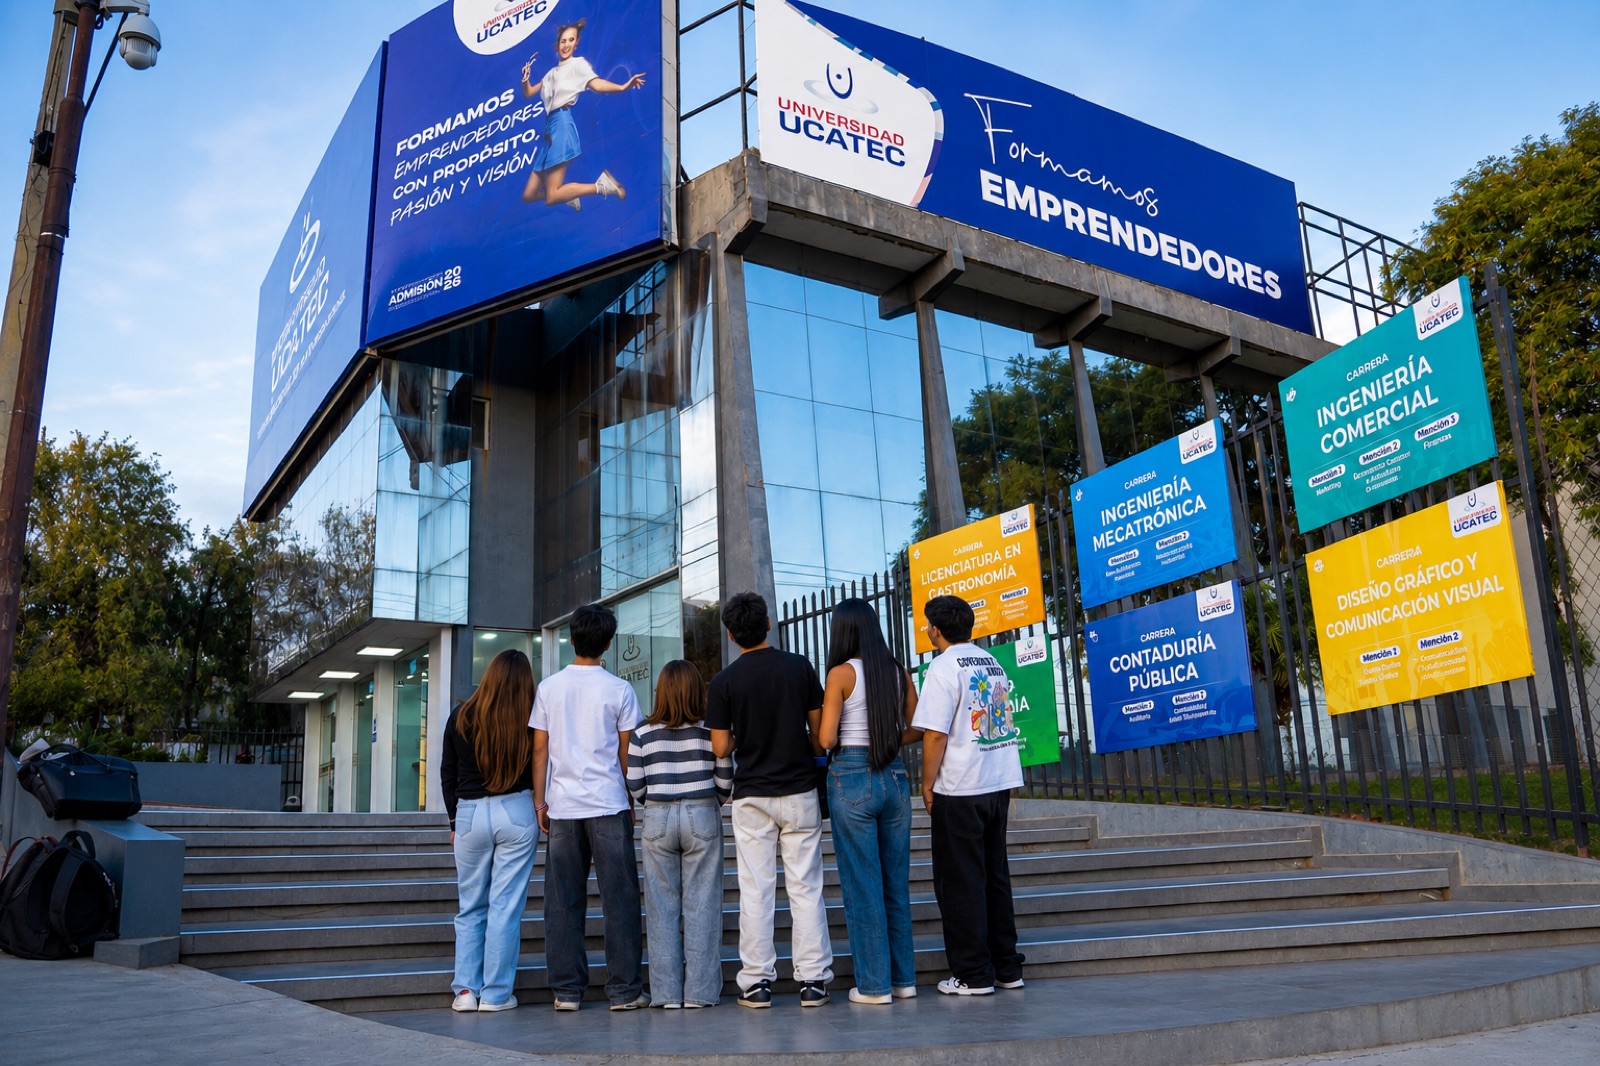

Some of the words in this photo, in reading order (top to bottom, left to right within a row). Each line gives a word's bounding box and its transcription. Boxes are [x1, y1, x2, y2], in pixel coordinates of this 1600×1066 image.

[477, 1, 547, 43] UCATEC
[393, 101, 545, 180] EMPRENDEDORES
[395, 88, 515, 157] FORMAMOS
[778, 96, 905, 147] UNIVERSIDAD
[779, 110, 906, 167] UCATEC
[393, 175, 428, 200] CON
[433, 128, 541, 183] PROPÓSITO,
[963, 92, 1159, 217] Formamos
[390, 183, 454, 227] PASIÓN
[460, 177, 471, 195] Y
[477, 146, 538, 187] VISIÓN
[979, 168, 1282, 300] EMPRENDEDORES
[388, 276, 444, 307] ADMISIÓN
[443, 275, 462, 291] 26
[444, 265, 462, 281] 20
[1419, 307, 1459, 334] UCATEC
[1346, 353, 1389, 382] CARRERA
[1316, 354, 1433, 428] INGENIERÍA
[1320, 385, 1439, 454] COMERCIAL
[1183, 440, 1214, 460] UCATEC
[1101, 475, 1192, 527] INGENIERÍA
[1124, 470, 1157, 490] CARRERA
[1092, 494, 1207, 553] MECATRÓNICA
[1453, 510, 1498, 532] UCATEC
[921, 550, 1002, 586] LICENCIATURA
[1005, 542, 1022, 559] EN
[1376, 546, 1423, 569] CARRERA
[1337, 580, 1391, 611] DISEÑO
[1394, 557, 1464, 594] GRÁFICO
[1466, 552, 1478, 572] Y
[1200, 602, 1232, 617] UCATEC
[1325, 592, 1440, 639] COMUNICACIÓN
[1442, 575, 1505, 606] VISUAL
[1109, 630, 1217, 673] CONTADURÍA
[1140, 627, 1176, 643] CARRERA
[1420, 635, 1452, 649] Mención
[1452, 631, 1459, 641] 2
[620, 667, 650, 682] ATEC
[1128, 661, 1199, 692] PÚBLICA
